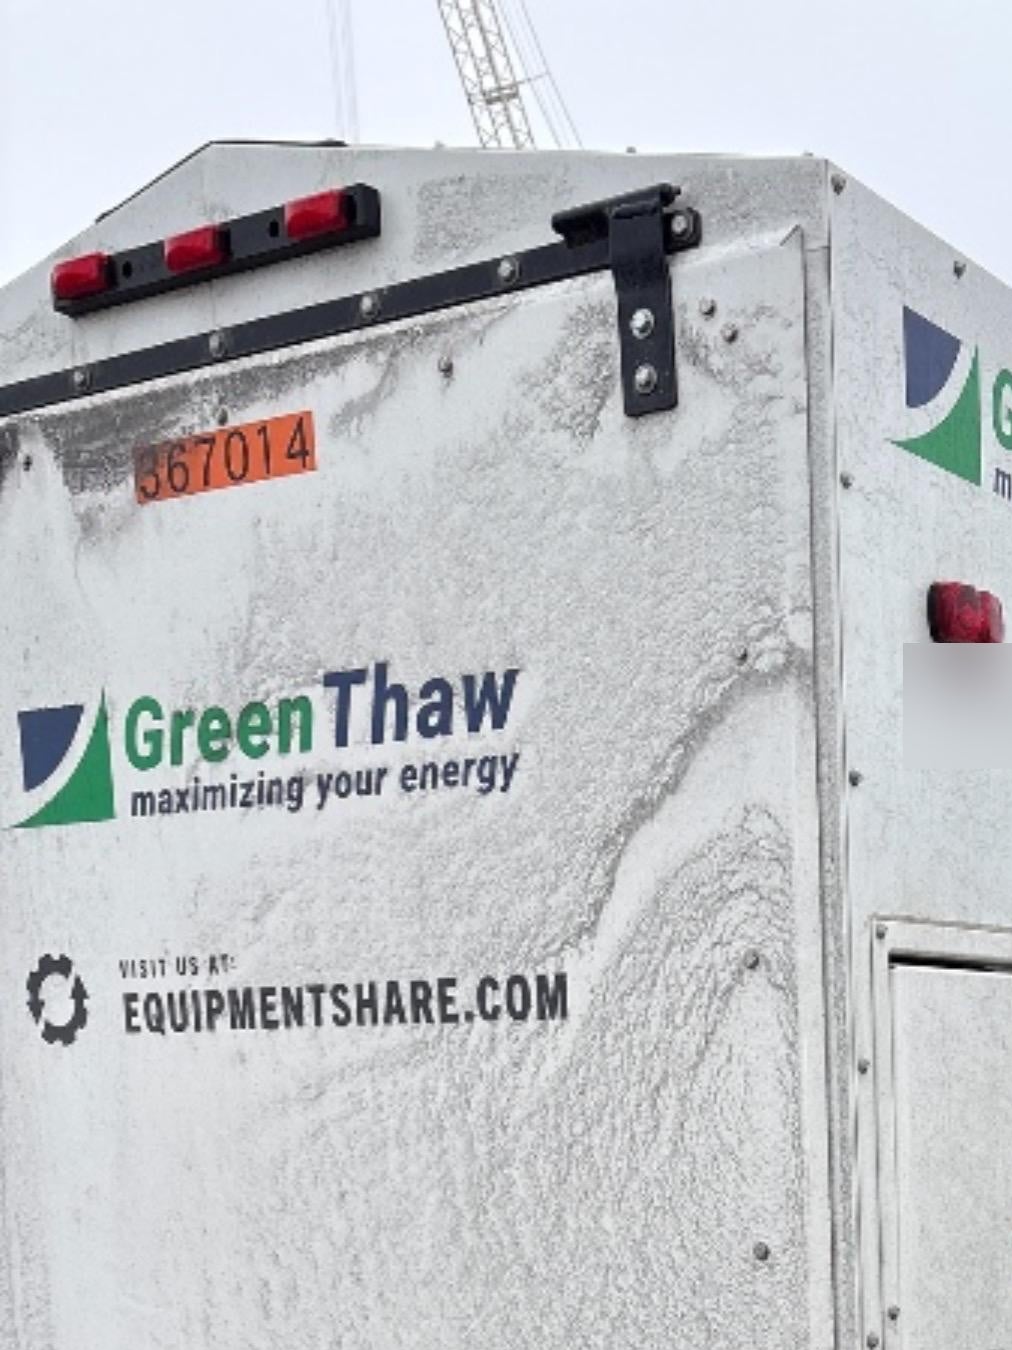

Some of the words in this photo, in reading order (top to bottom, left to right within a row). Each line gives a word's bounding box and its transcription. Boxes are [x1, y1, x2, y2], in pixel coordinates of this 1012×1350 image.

[138, 415, 311, 500] 367014
[130, 770, 305, 818] maximizing
[316, 766, 389, 811] your
[399, 752, 521, 795] energy
[118, 958, 167, 979] VISIT
[175, 956, 199, 976] US
[122, 971, 569, 1036] EQUIPMENTSHARE.COM
